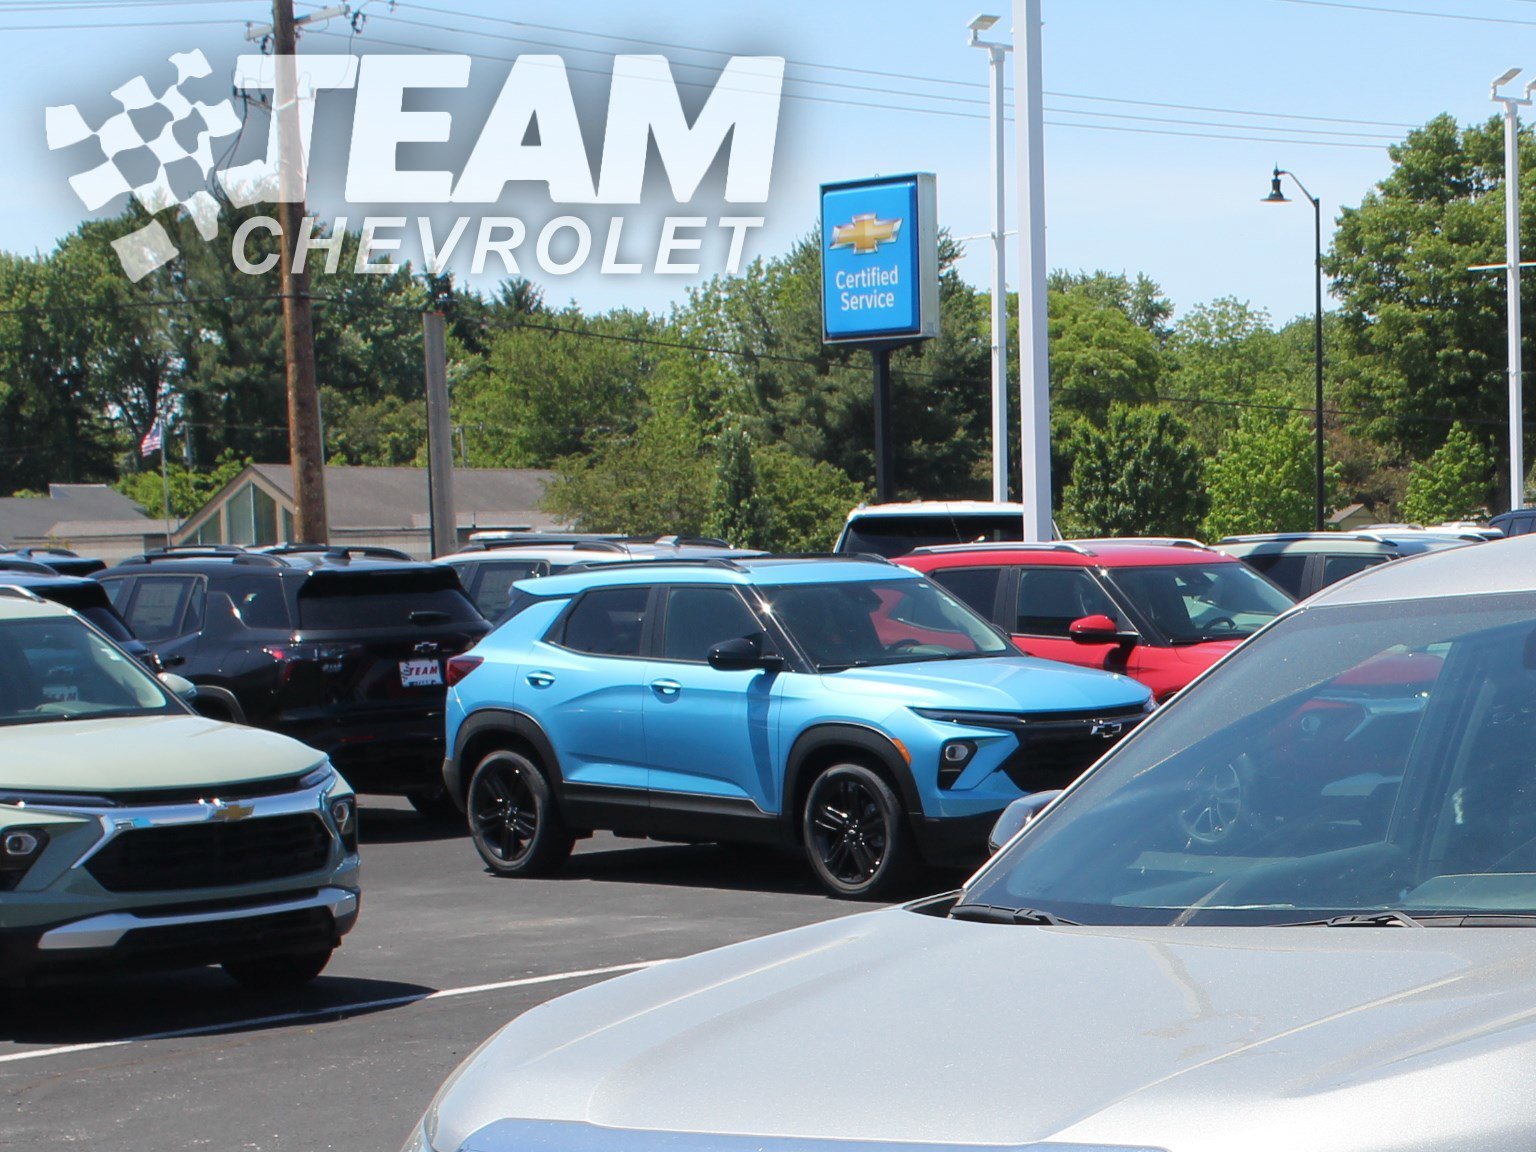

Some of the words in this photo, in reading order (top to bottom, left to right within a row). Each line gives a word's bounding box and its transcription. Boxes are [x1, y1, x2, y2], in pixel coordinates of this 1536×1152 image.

[835, 265, 899, 289] Certified
[840, 289, 895, 311] Service
[408, 666, 438, 677] TEAM
